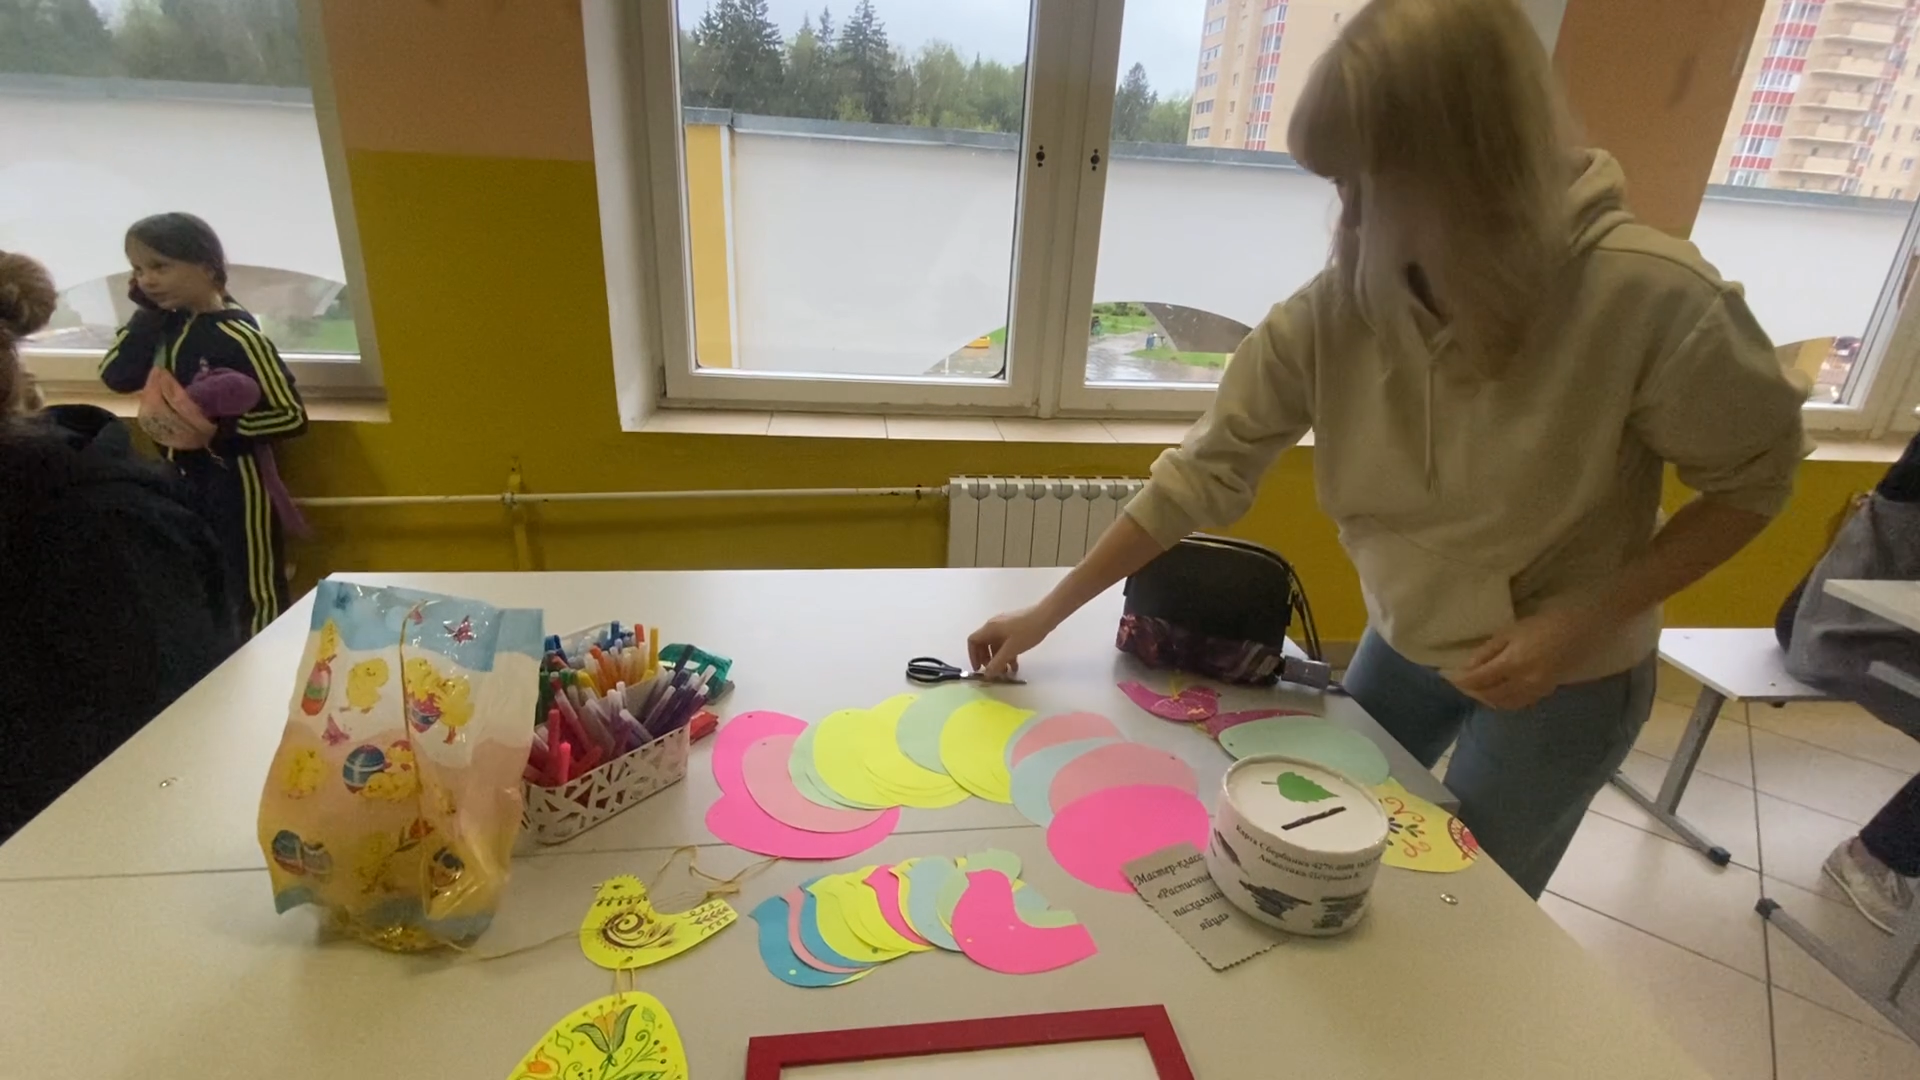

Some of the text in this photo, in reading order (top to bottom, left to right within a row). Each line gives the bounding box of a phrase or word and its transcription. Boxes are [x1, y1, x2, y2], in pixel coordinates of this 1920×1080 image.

[1157, 872, 1212, 899] «Расписны
[1172, 891, 1224, 917] пасхальн
[1199, 912, 1229, 931] яйца»
